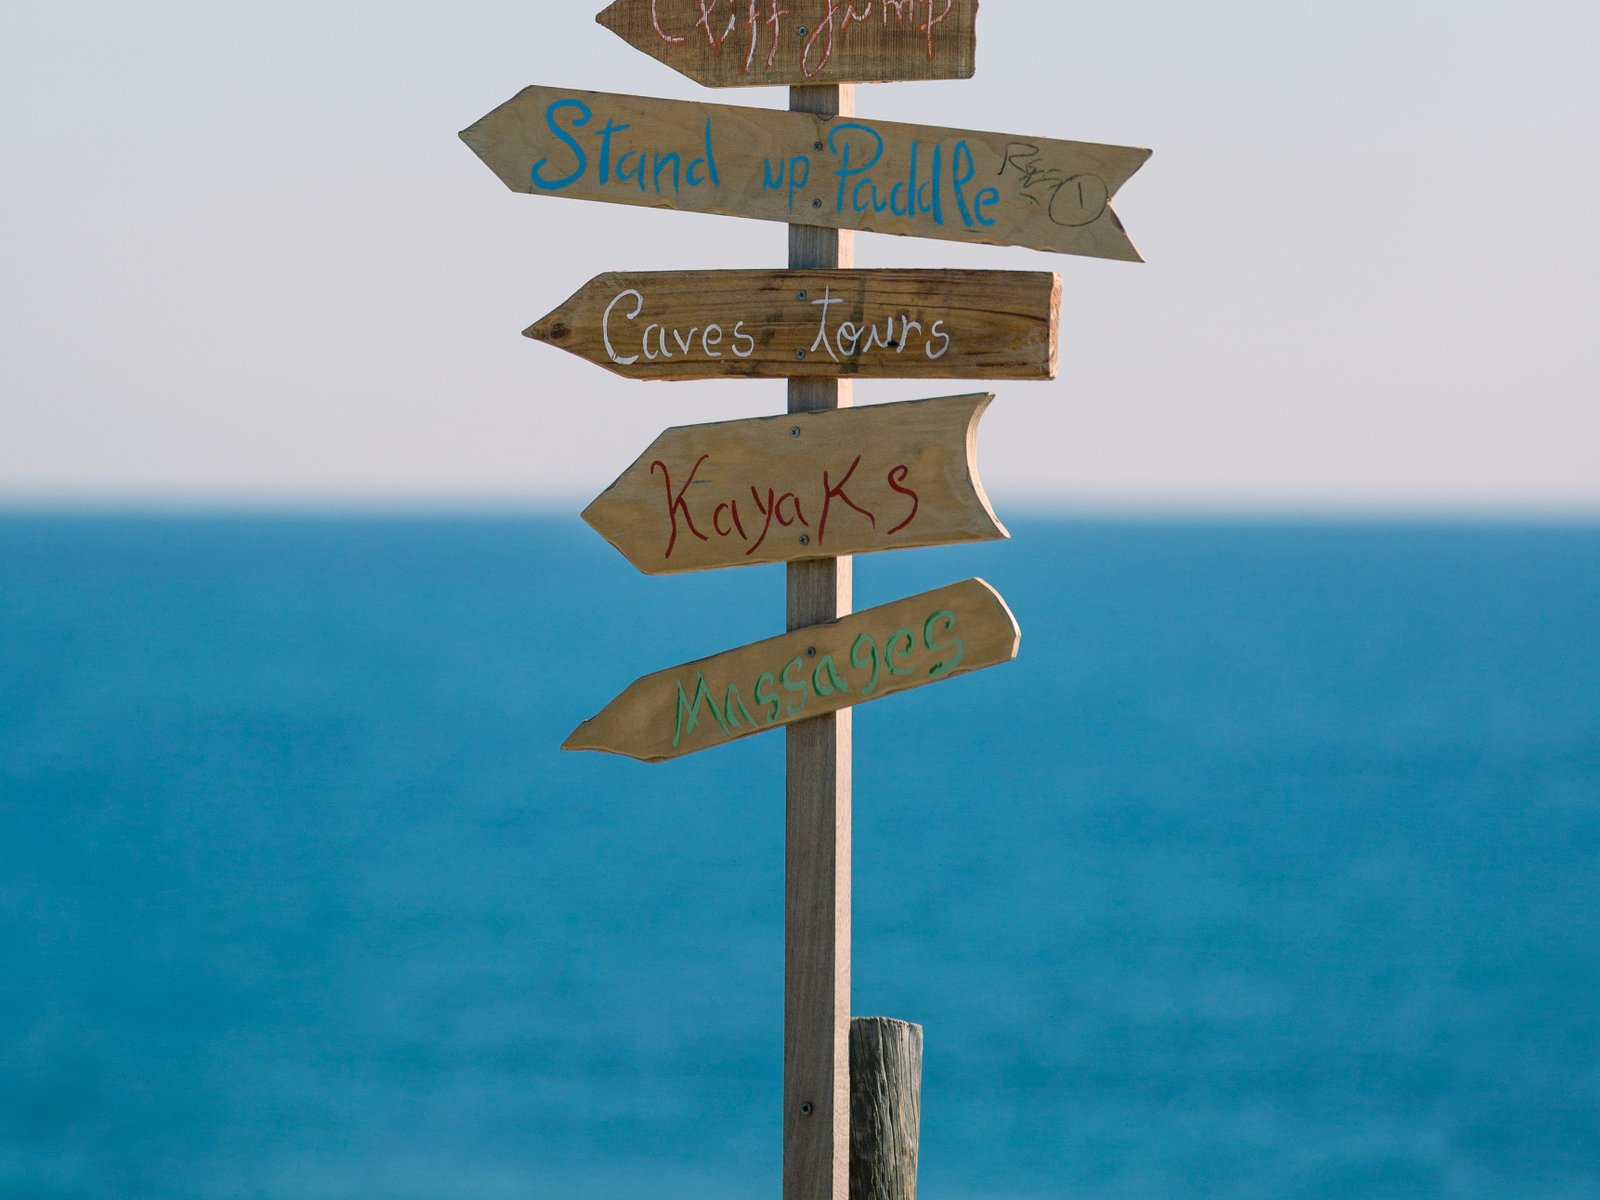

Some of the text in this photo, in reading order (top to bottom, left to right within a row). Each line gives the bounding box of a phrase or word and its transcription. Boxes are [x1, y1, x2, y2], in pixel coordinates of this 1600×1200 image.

[531, 99, 720, 194] Stand
[762, 154, 810, 213] up
[828, 122, 1001, 228] Paddle
[602, 285, 951, 365] Caves tours
[672, 609, 965, 749] Massages
